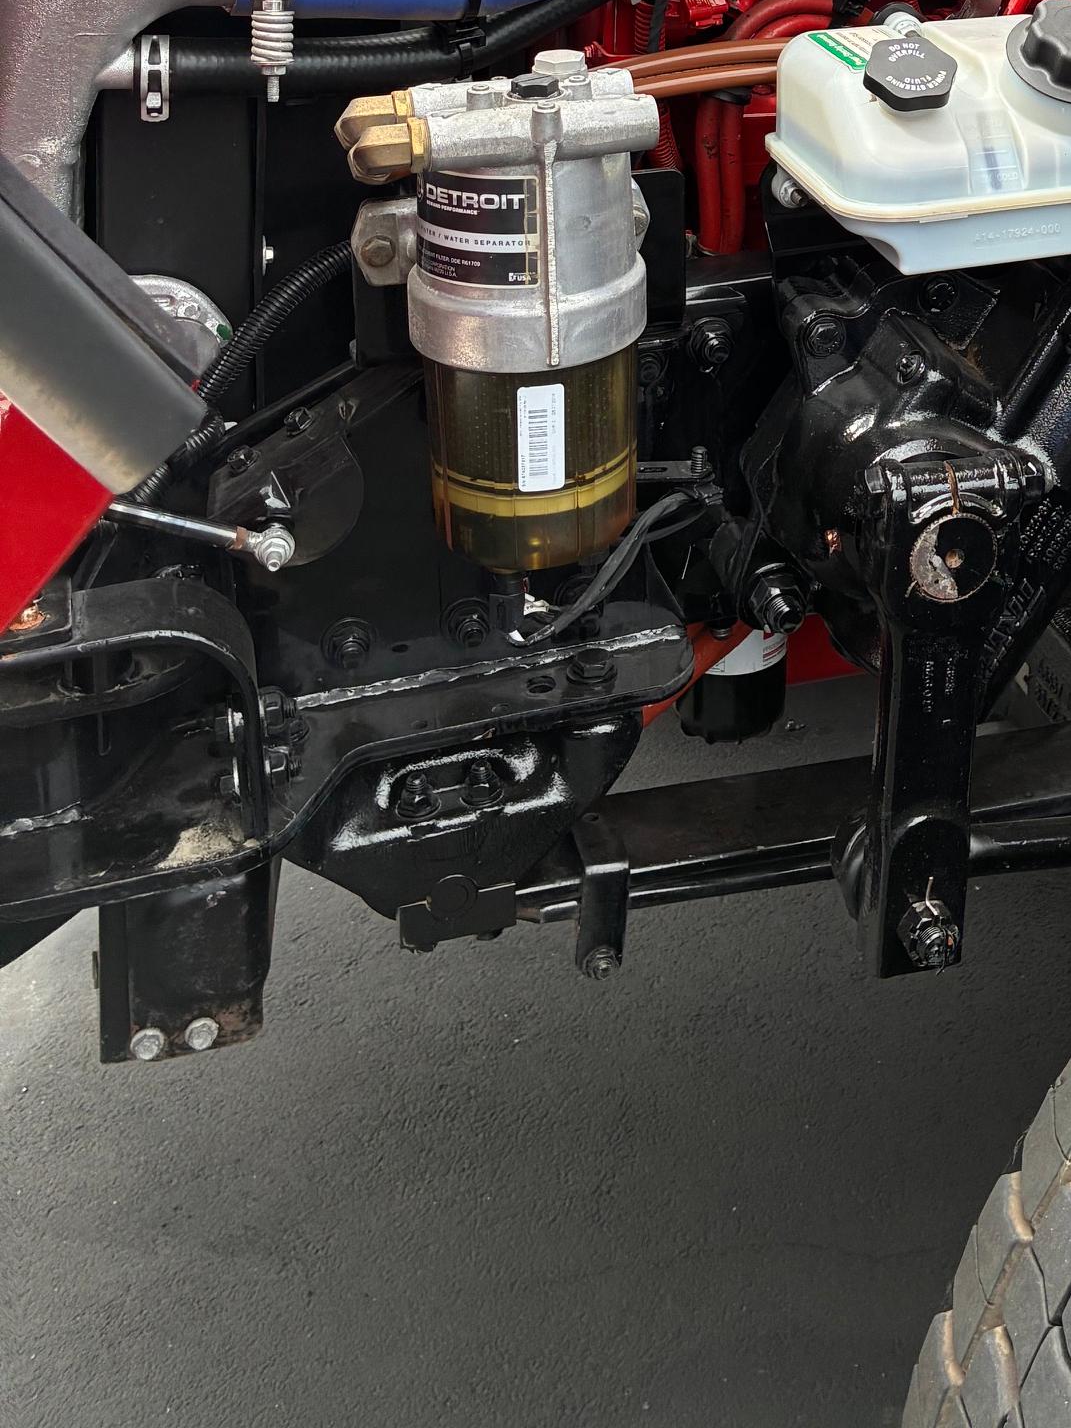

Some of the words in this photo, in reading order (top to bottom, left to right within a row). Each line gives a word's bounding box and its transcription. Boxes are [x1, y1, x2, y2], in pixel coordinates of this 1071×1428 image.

[888, 44, 901, 52] DO
[902, 42, 920, 50] NOT
[888, 49, 925, 62] OVERFILL
[885, 75, 927, 91] STEERING
[904, 74, 932, 84] FLUID
[926, 70, 947, 89] POWER
[426, 182, 526, 210] DETROIT
[444, 234, 470, 245] WATER
[474, 239, 531, 247] SEPARATOR
